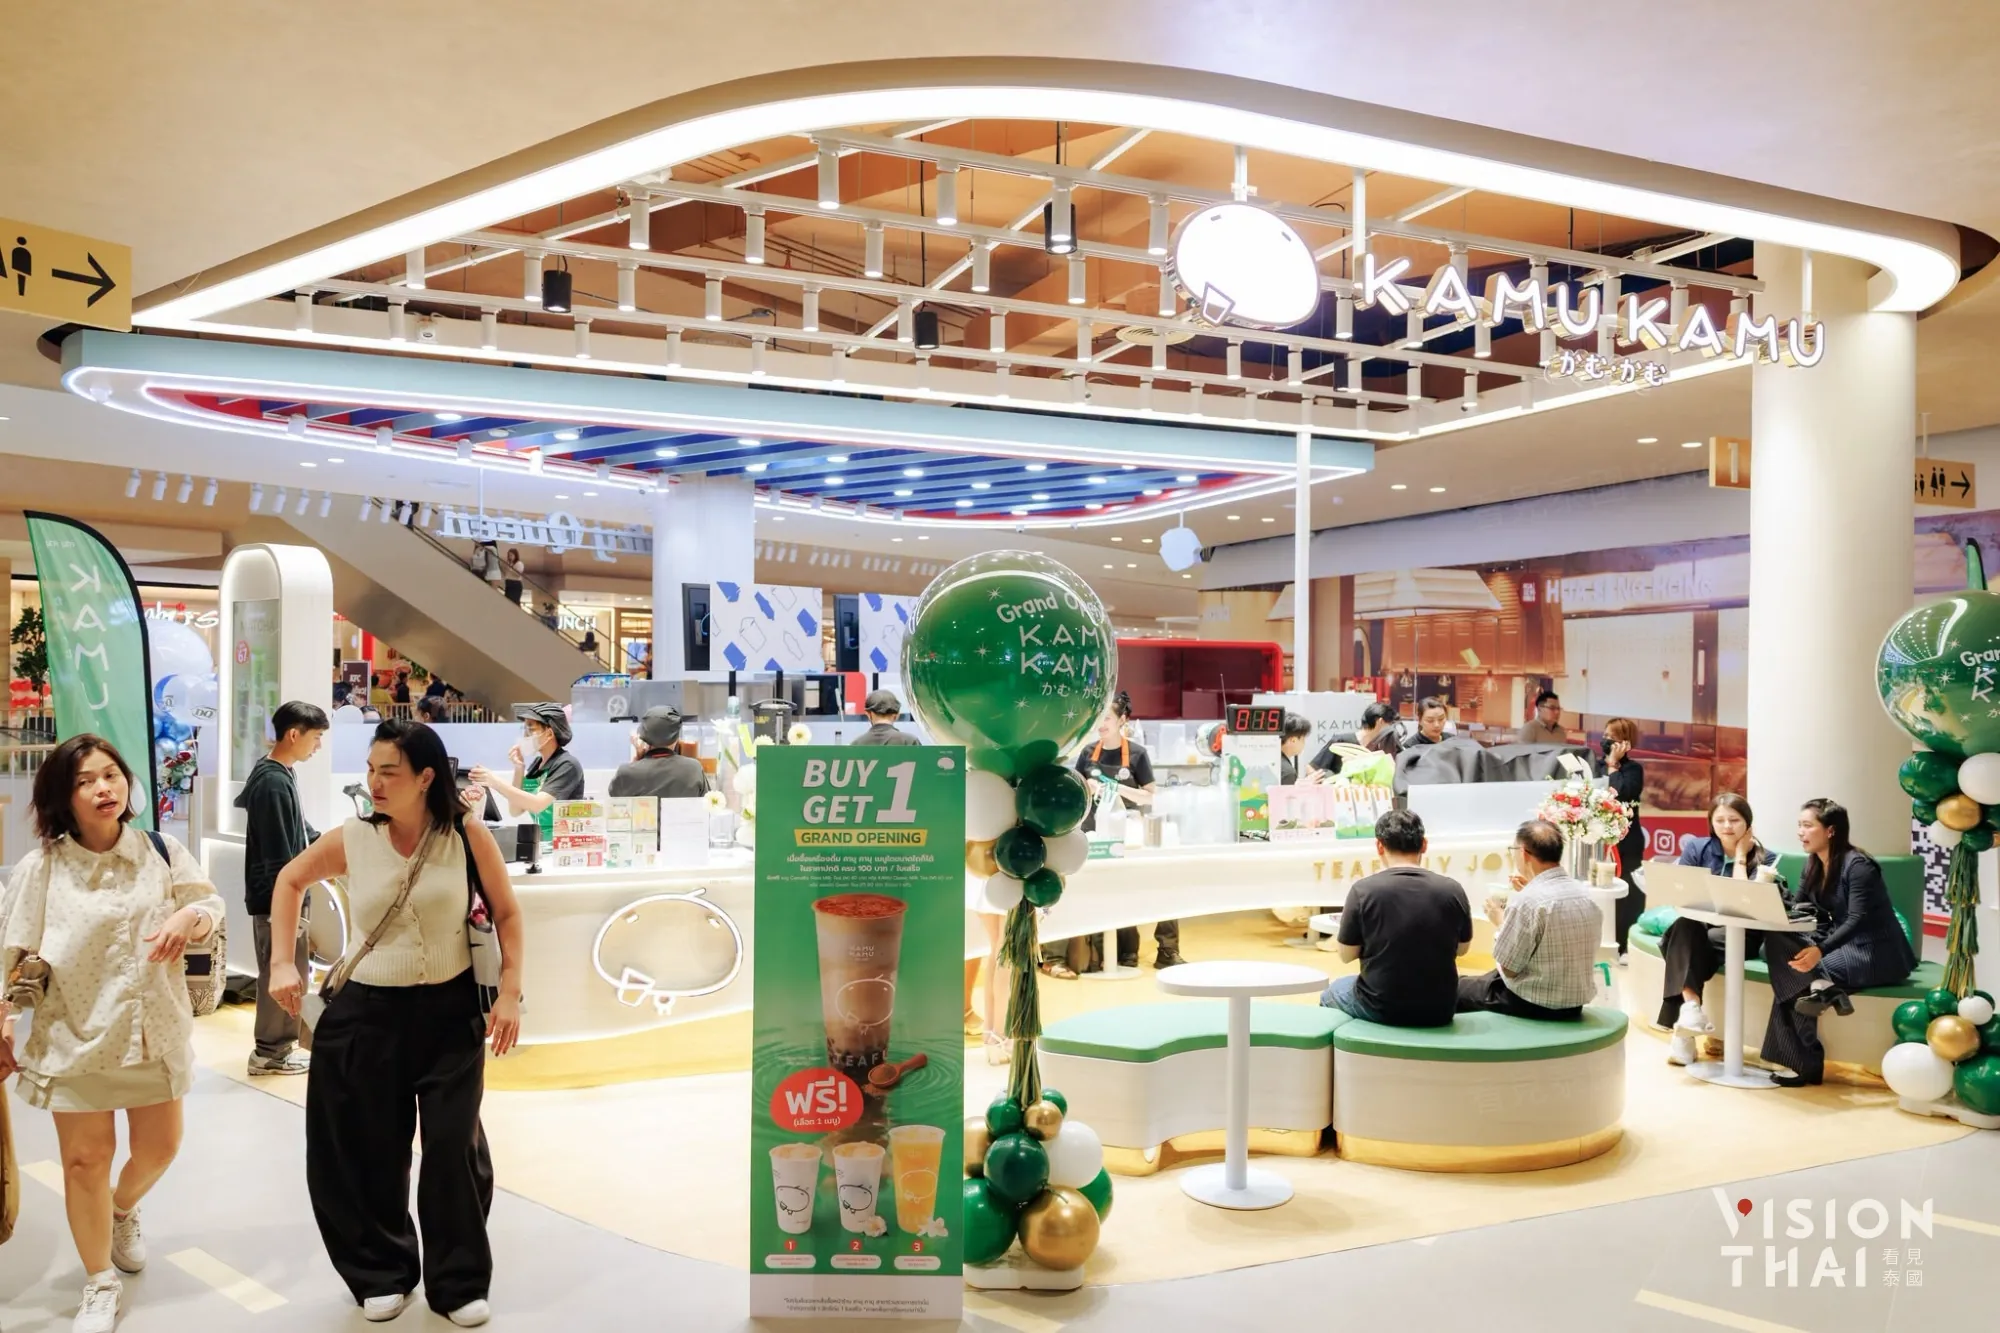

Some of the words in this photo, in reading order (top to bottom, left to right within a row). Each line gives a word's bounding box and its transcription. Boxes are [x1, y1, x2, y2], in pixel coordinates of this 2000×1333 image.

[1362, 251, 1602, 338] KAMU
[1626, 291, 1825, 368] KAMU
[996, 591, 1059, 623] Grand
[1236, 708, 1280, 732] 015
[802, 758, 879, 788] BUY
[876, 761, 917, 824] 1
[802, 795, 874, 825] GET
[801, 832, 853, 844] GRAND
[856, 832, 921, 844] OPENING
[857, 865, 873, 873] 100
[785, 1075, 848, 1115] ฟรี!
[852, 1241, 860, 1250] 2
[913, 1242, 921, 1251] 3
